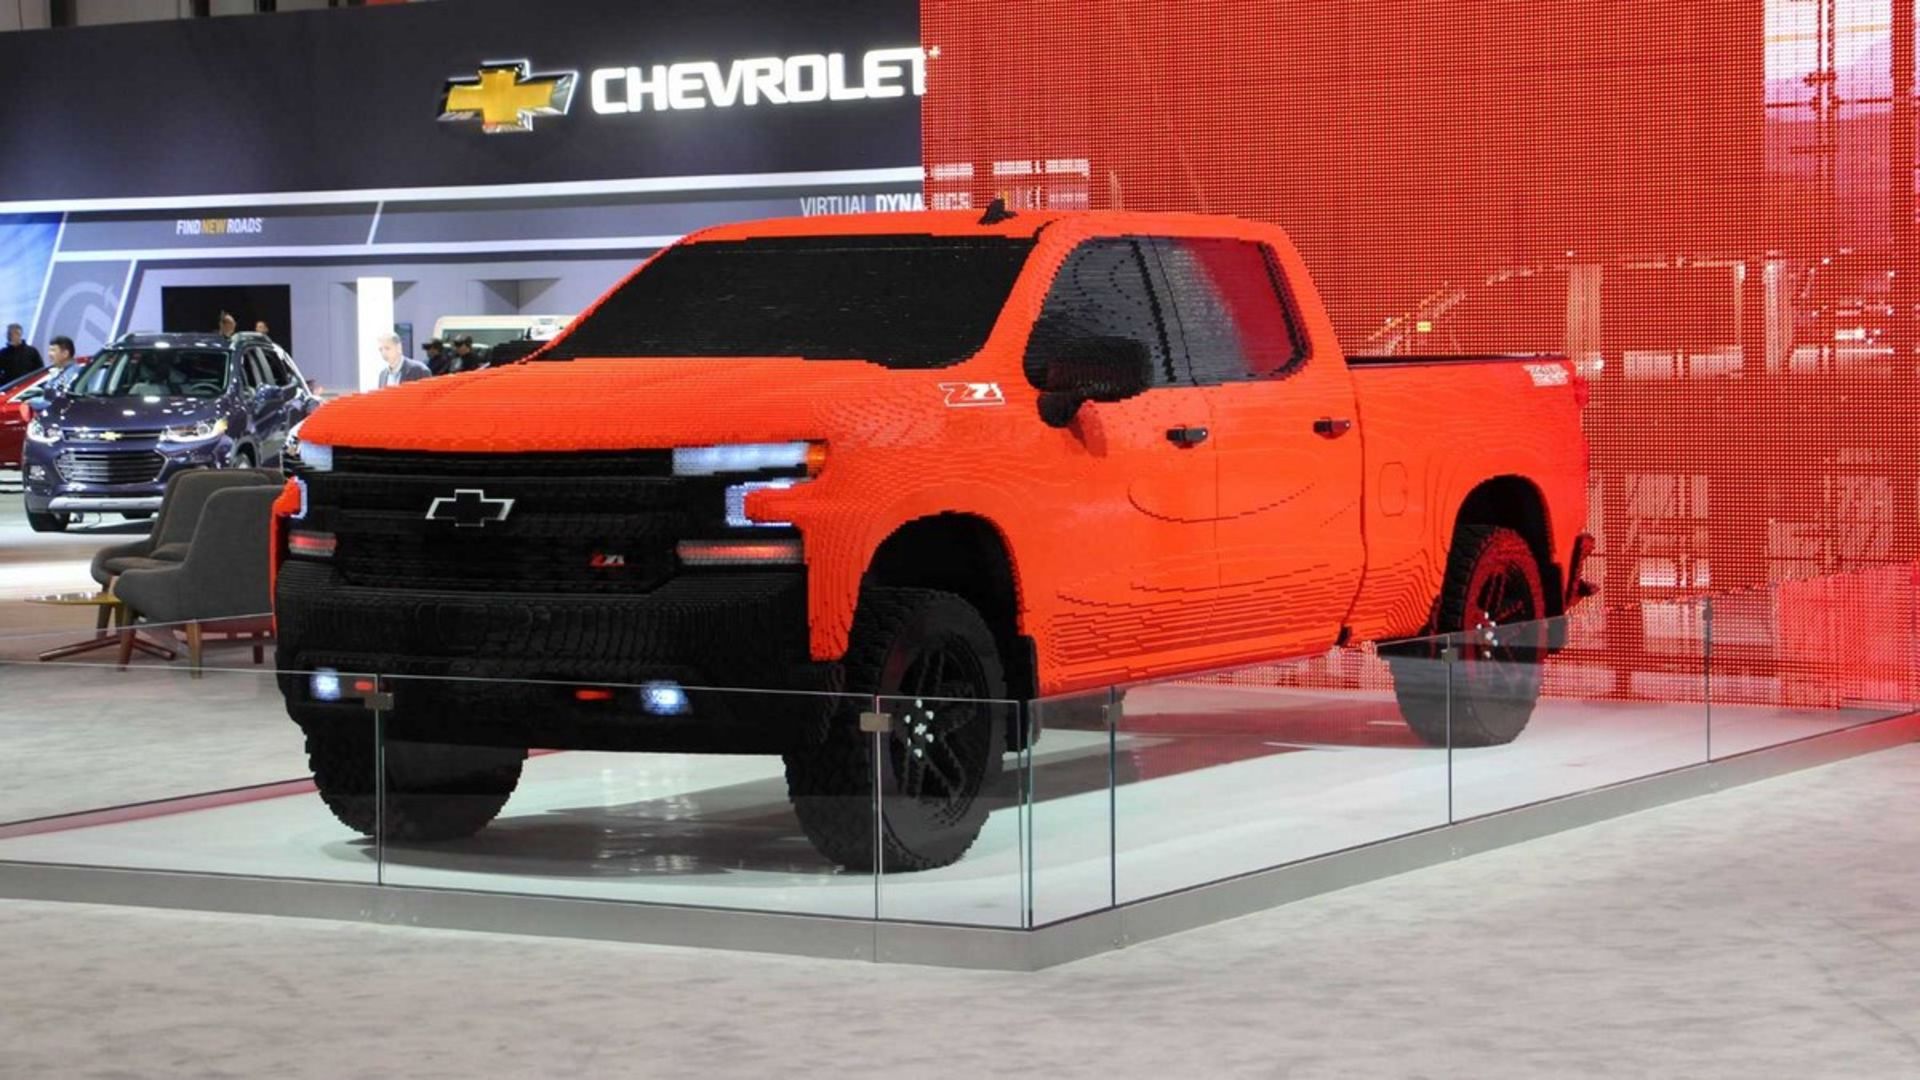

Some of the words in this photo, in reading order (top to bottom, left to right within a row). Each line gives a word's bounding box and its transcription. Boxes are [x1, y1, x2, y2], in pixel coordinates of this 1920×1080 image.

[591, 47, 927, 114] CHEVROLET
[176, 219, 200, 235] FIND
[226, 217, 262, 233] ROADS
